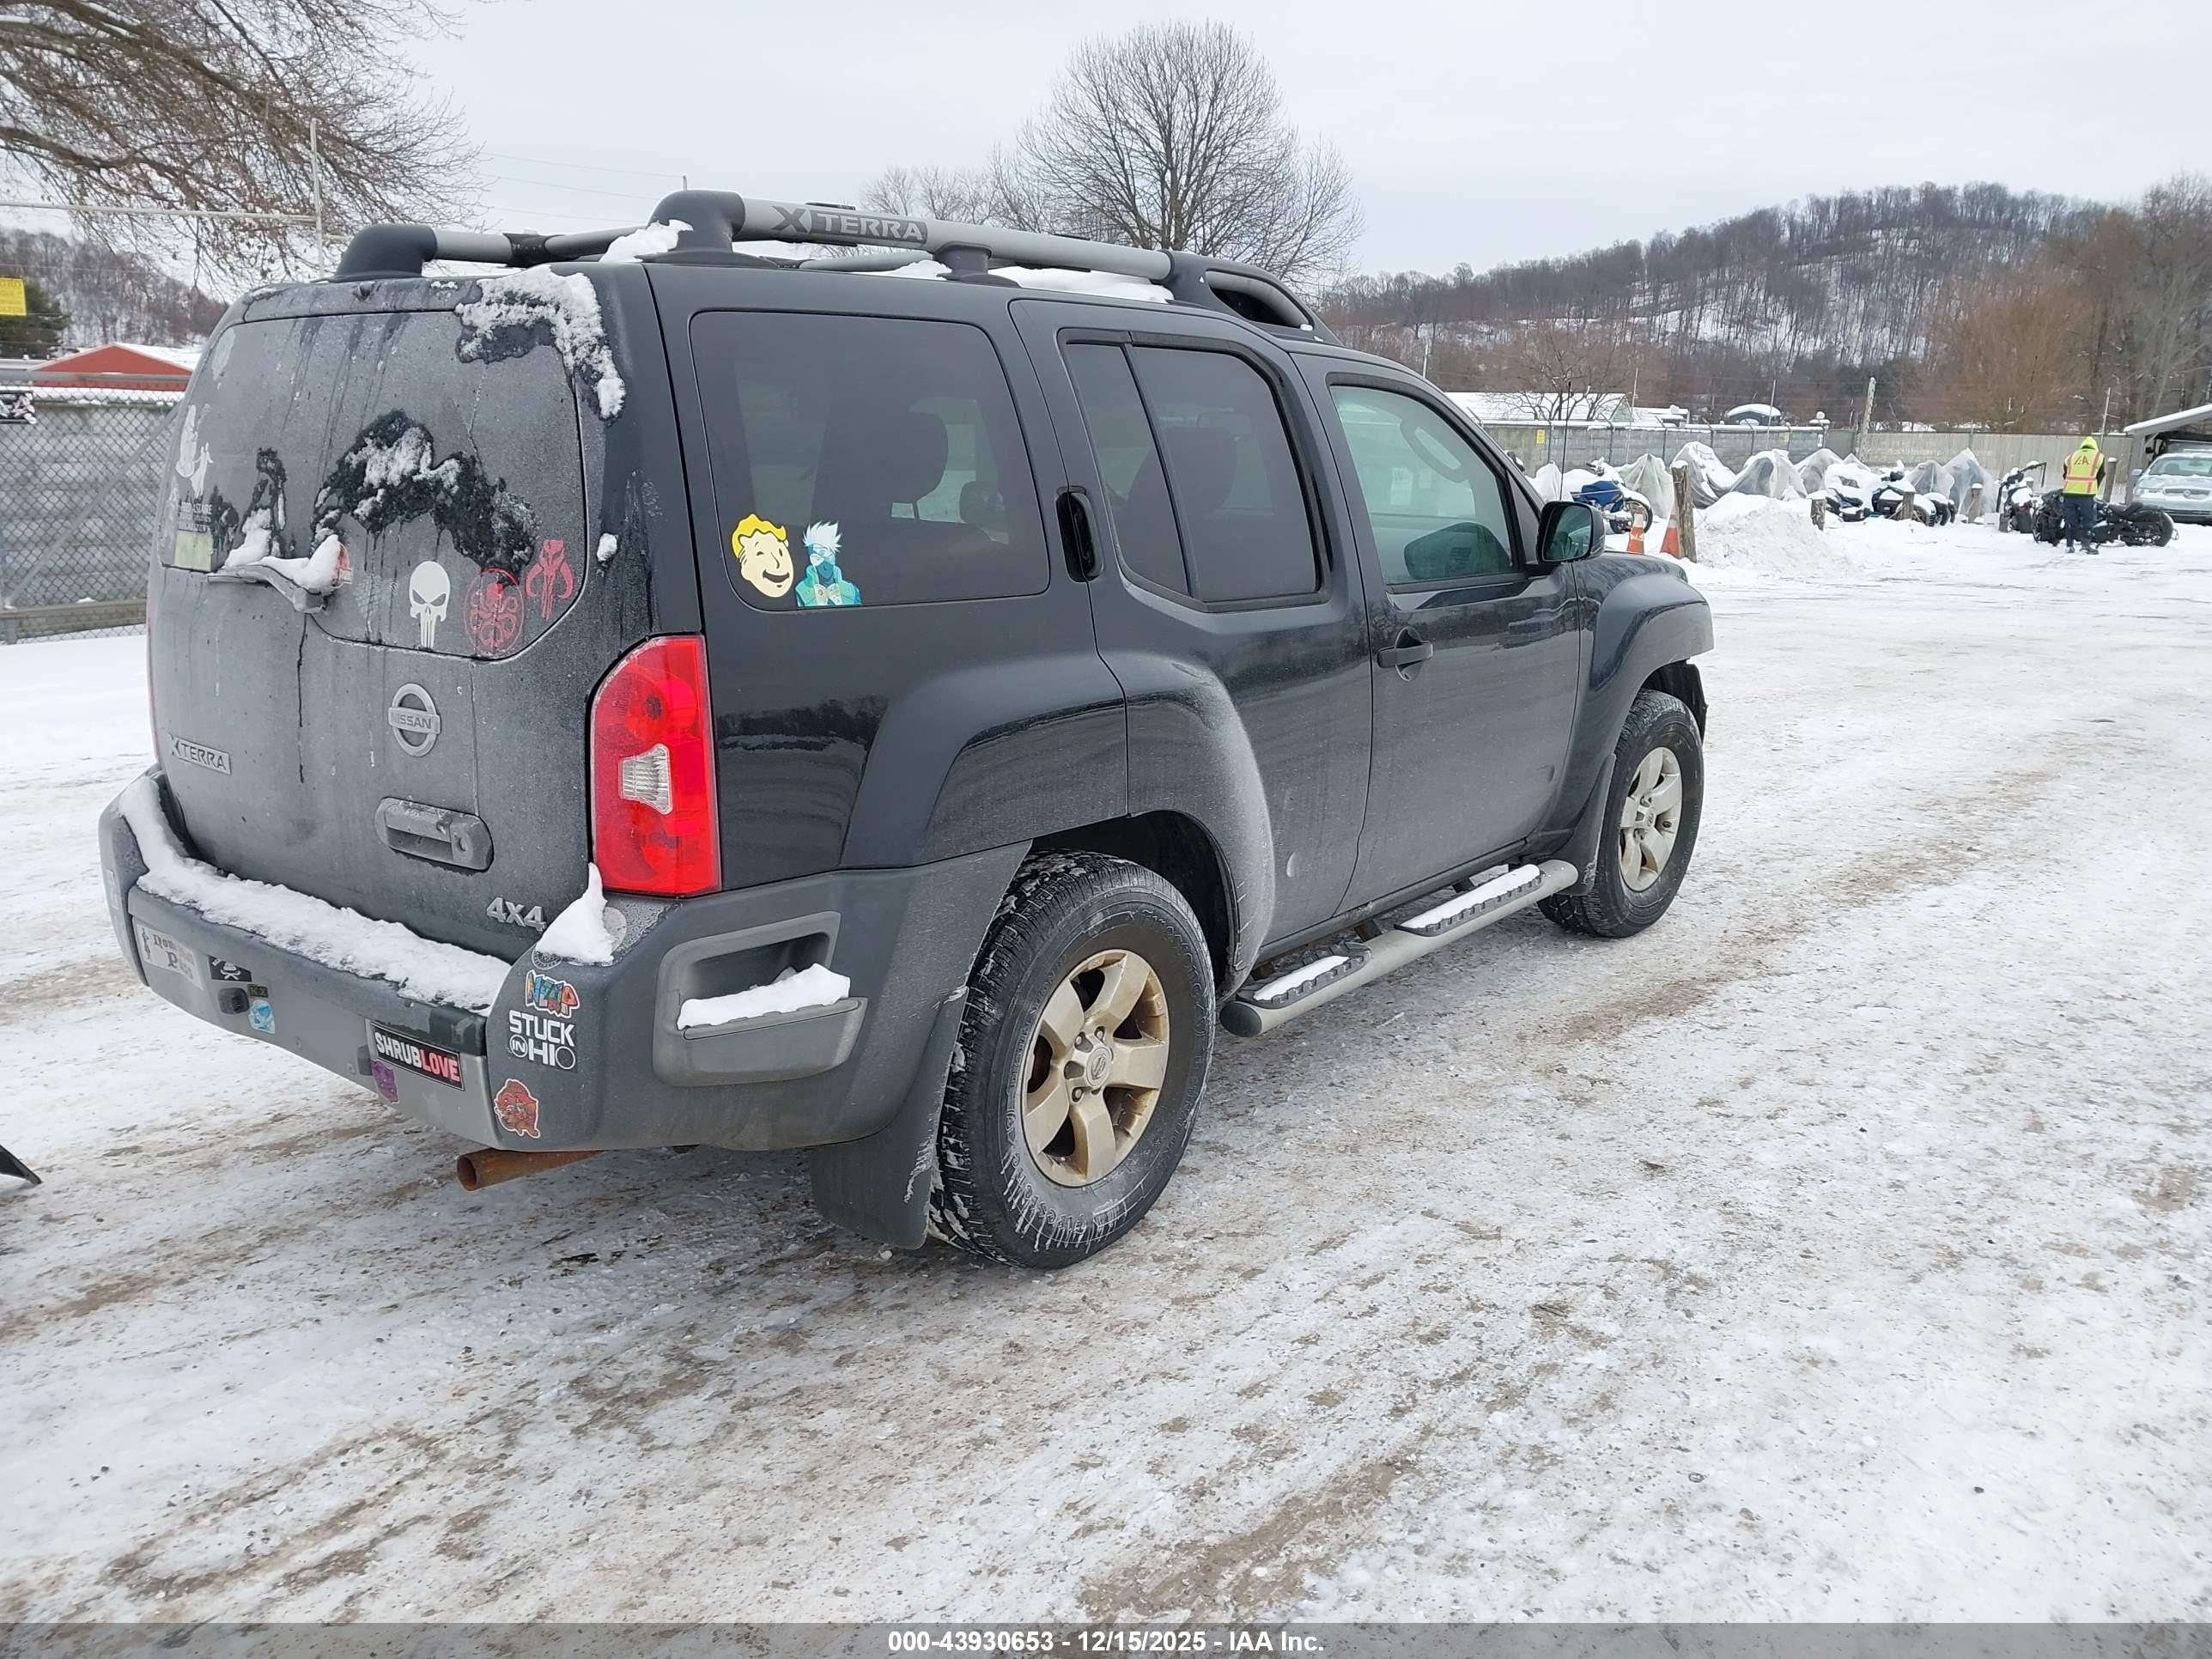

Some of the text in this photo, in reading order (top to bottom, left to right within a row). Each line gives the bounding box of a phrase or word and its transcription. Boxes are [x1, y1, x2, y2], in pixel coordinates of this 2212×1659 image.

[772, 205, 924, 241] XTERRA
[167, 732, 228, 772] XTERRA
[509, 1009, 574, 1038] STUCK
